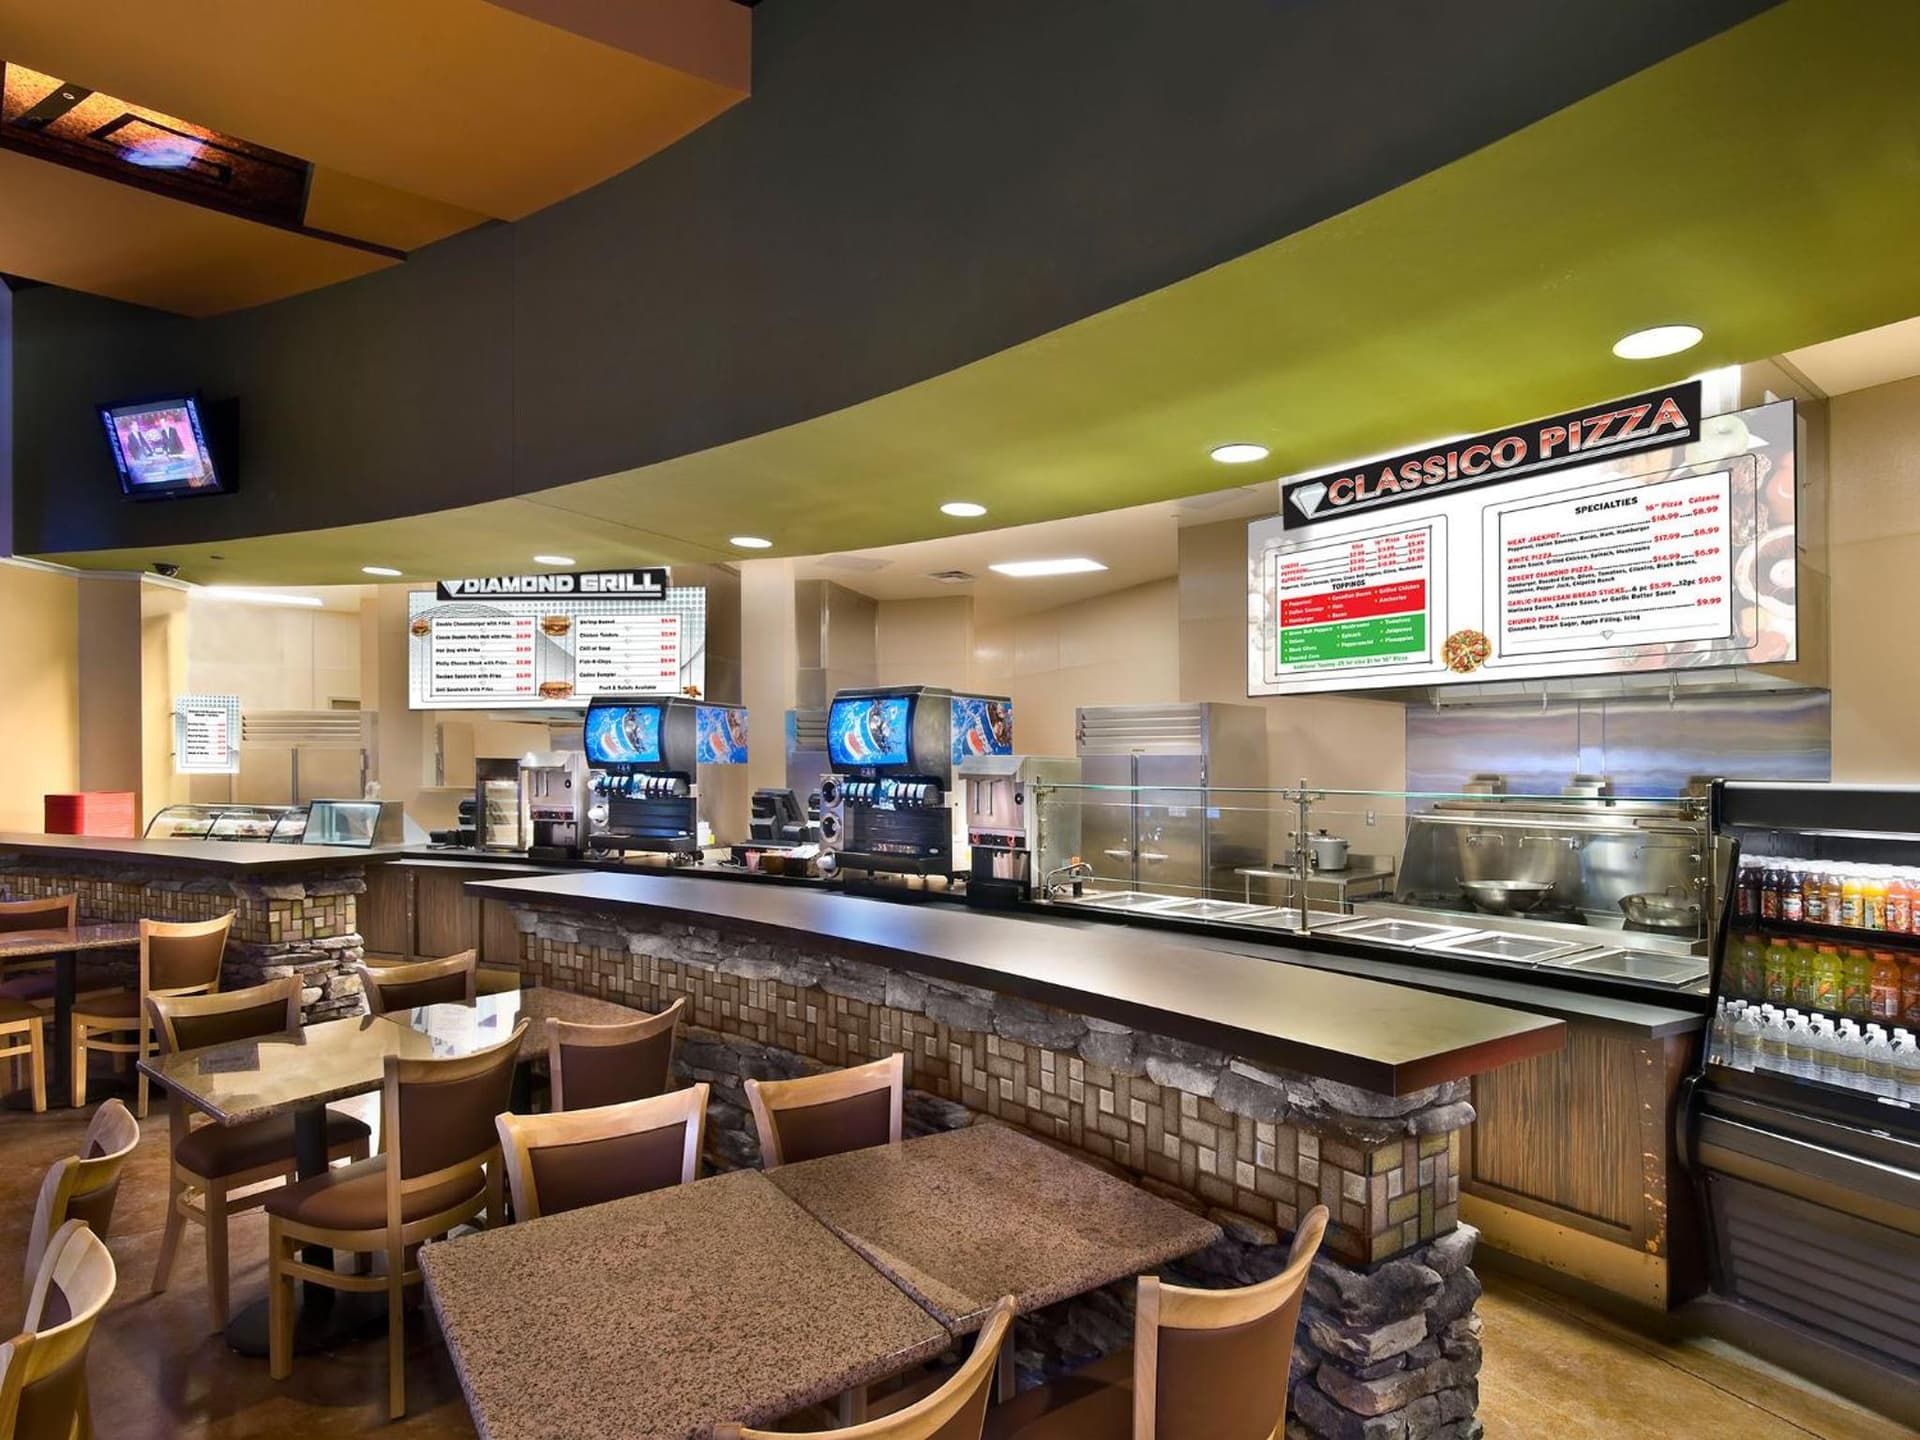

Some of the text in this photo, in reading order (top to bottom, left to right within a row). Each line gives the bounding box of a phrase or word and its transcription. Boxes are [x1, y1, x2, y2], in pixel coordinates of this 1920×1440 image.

[1328, 397, 1689, 505] CLASSICO PIZZA
[1575, 496, 1638, 515] SPECIALTIES
[1617, 526, 1649, 534] Hamburger
[1528, 532, 1560, 542] JACKPOT
[1616, 546, 1650, 554] Mushrooms
[1532, 552, 1552, 560] PIZZA
[1508, 574, 1534, 582] DESERT
[1536, 570, 1569, 578] DIAMOND
[1572, 566, 1593, 574] PIZZA
[464, 573, 662, 593] DIAMOND GRILL
[1332, 580, 1365, 590] TOPPINGS
[1599, 587, 1625, 595] STICKS
[1698, 575, 1722, 584] $9.99
[1697, 598, 1722, 606] $9.99
